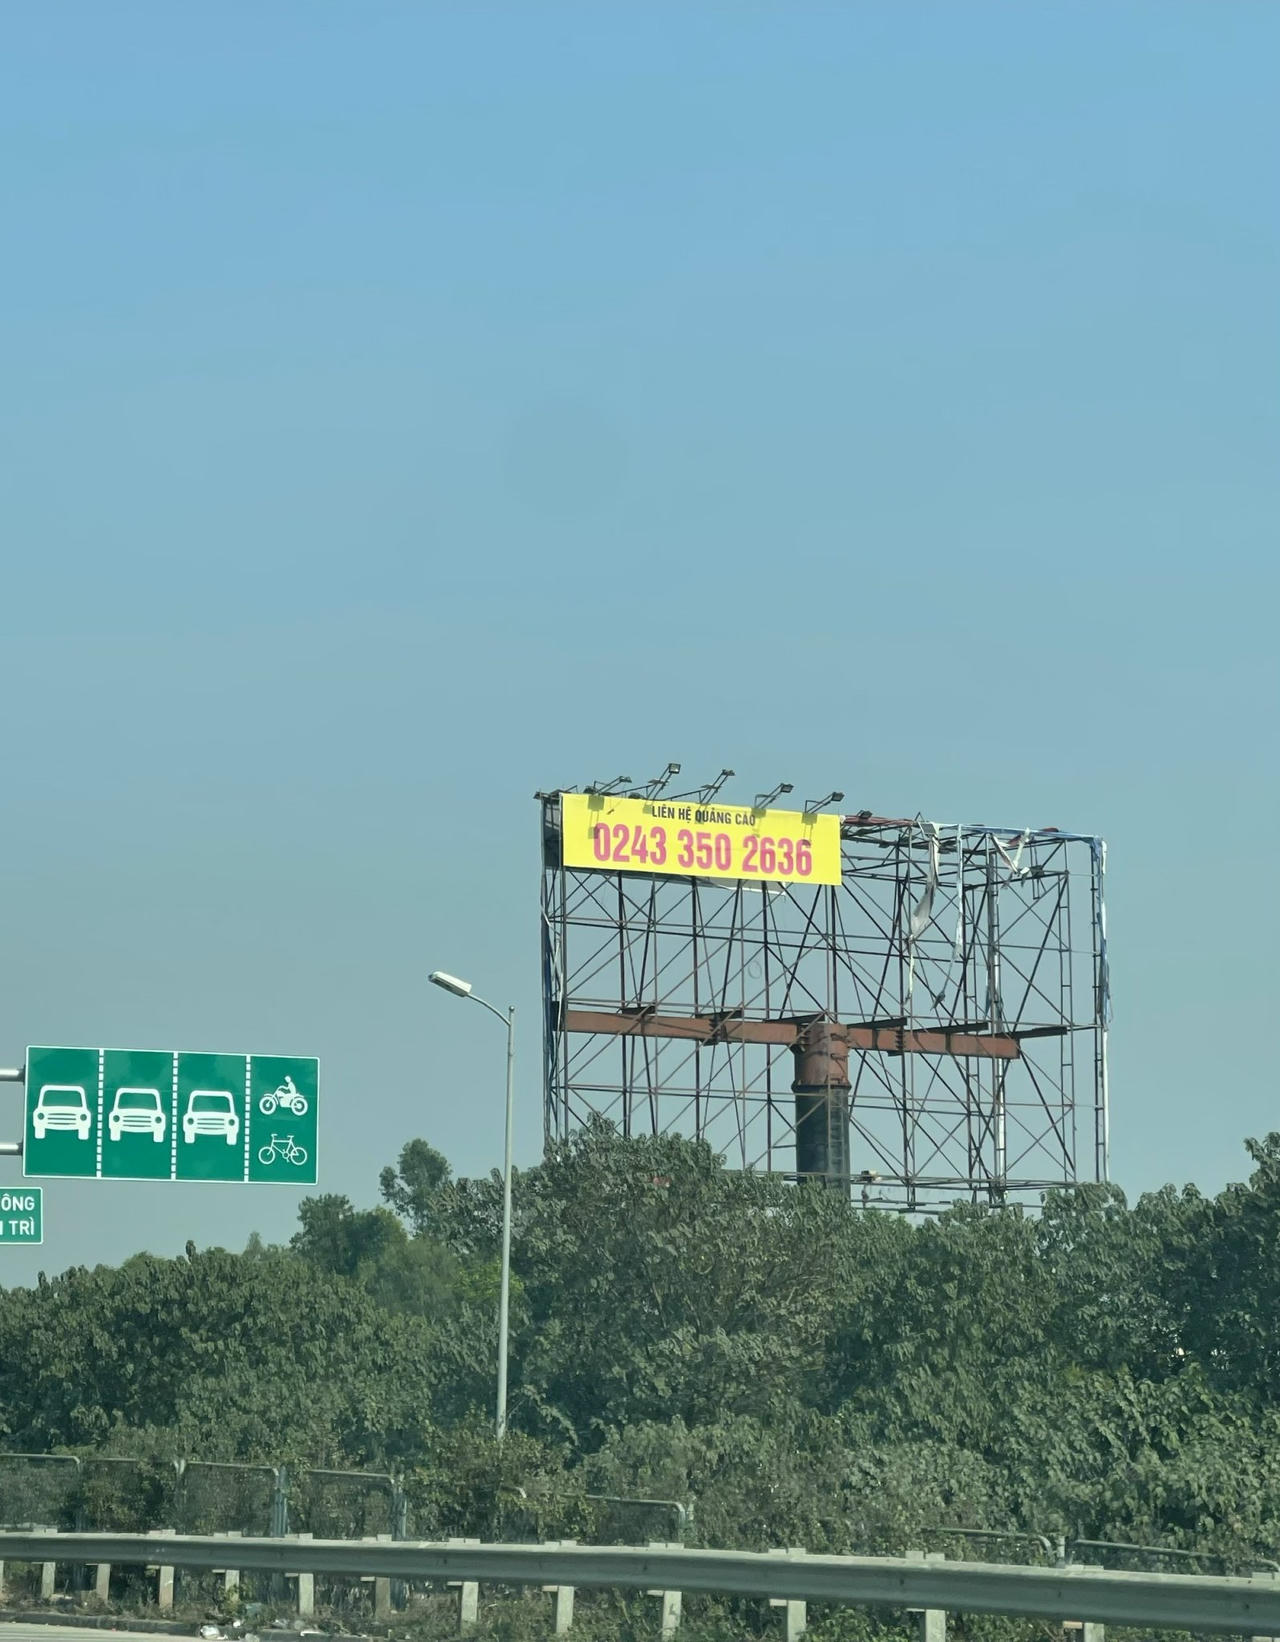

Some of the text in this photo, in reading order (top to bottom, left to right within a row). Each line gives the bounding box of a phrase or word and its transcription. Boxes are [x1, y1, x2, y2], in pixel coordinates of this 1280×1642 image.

[652, 804, 675, 819] LIÊN
[678, 806, 691, 823] HỆ
[695, 807, 732, 824] QUẢNG
[594, 822, 812, 876] 0243 350 2636
[0, 1193, 35, 1211] ÔNG
[8, 1217, 35, 1236] TRÌ
